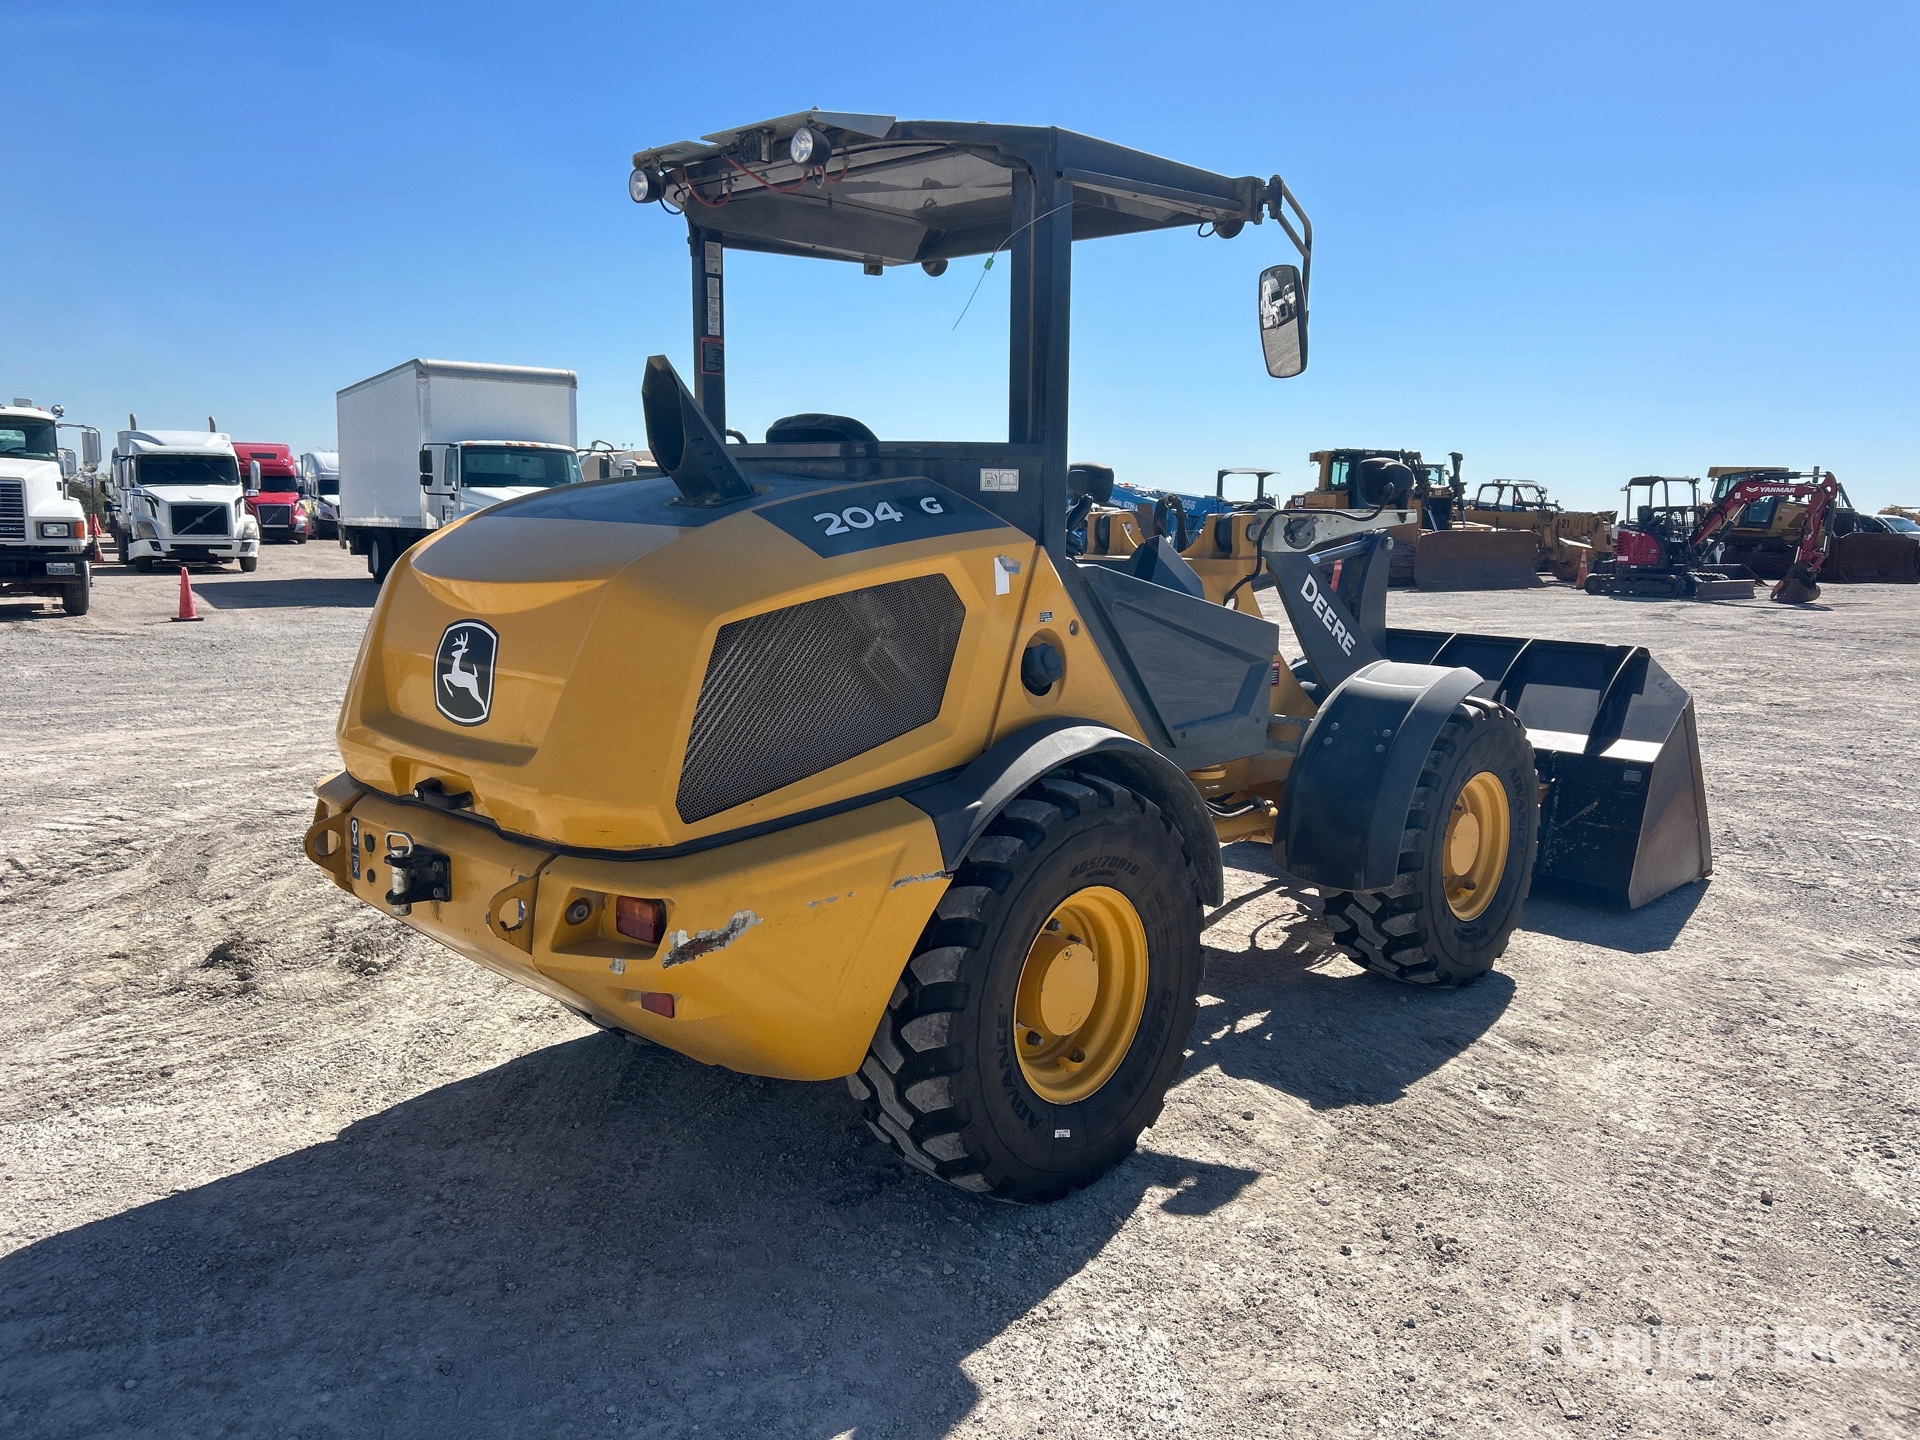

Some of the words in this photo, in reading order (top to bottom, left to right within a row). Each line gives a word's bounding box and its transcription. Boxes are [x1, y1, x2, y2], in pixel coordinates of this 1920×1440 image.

[813, 501, 904, 536] 204
[919, 496, 944, 515] G
[1294, 497, 1305, 506] CAT
[1300, 573, 1356, 657] DEERE
[997, 1013, 1042, 1134] ADVANCE
